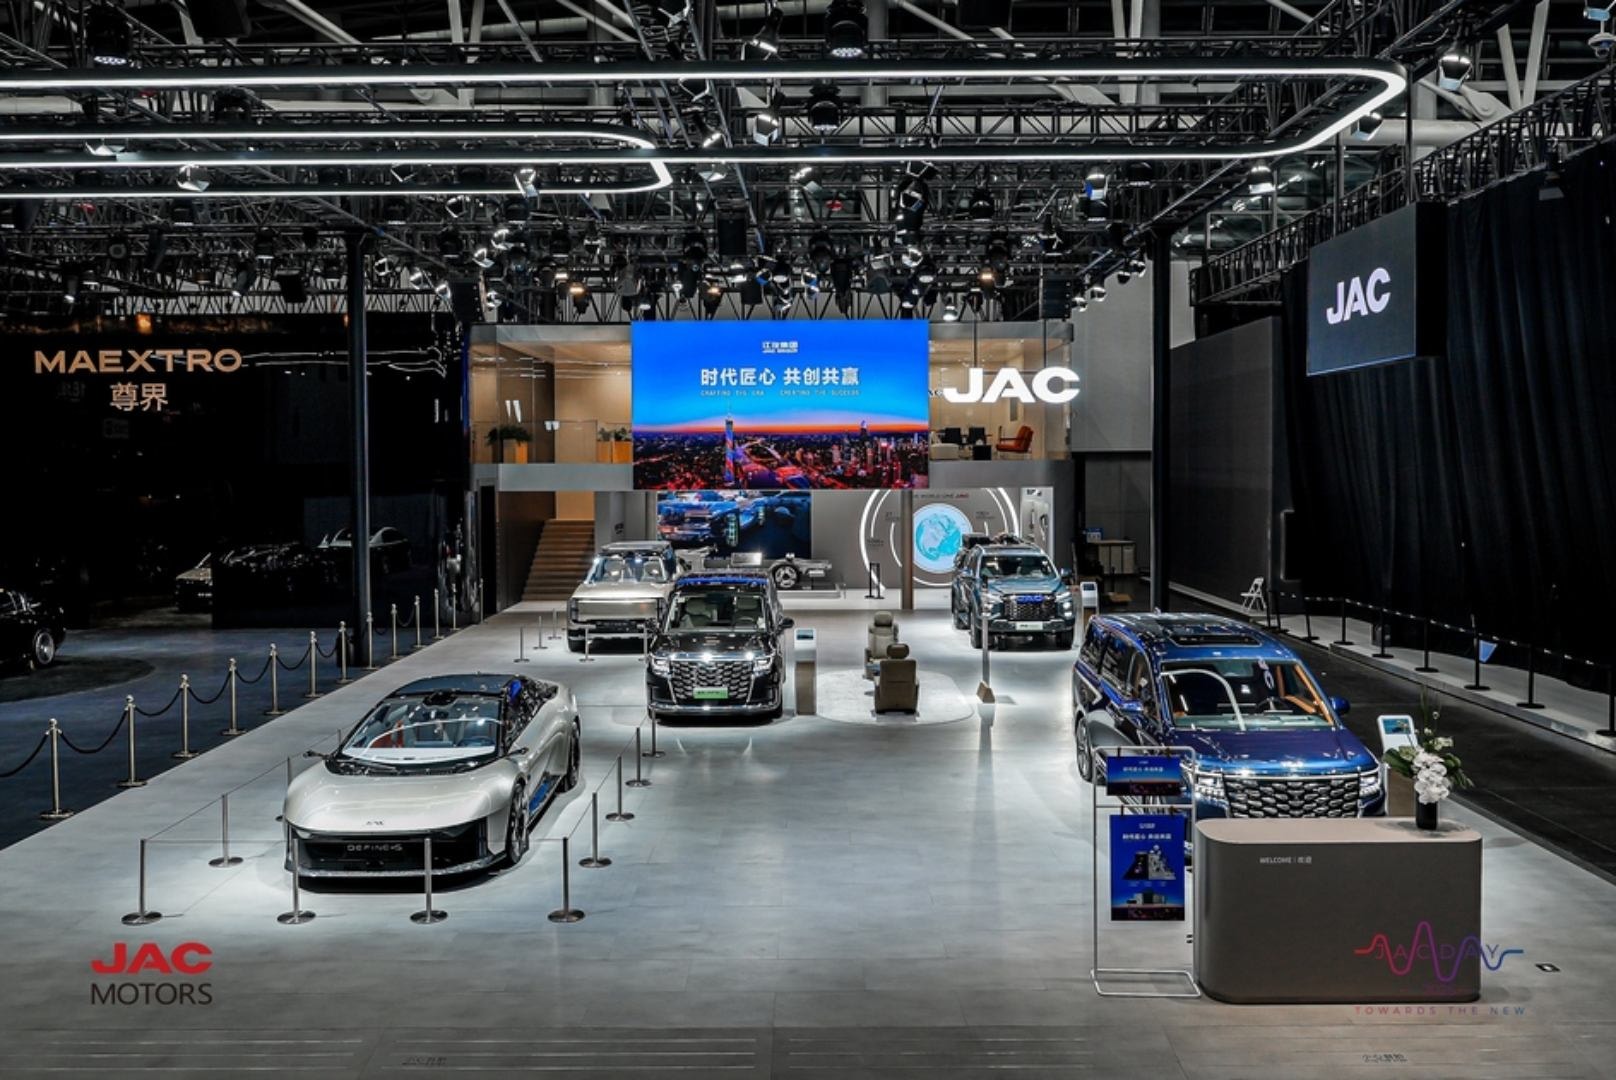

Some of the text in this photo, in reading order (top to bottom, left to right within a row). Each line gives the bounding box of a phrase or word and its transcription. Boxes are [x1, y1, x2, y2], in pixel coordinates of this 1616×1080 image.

[1326, 267, 1391, 325] JAC
[34, 349, 243, 374] MAEXTRO
[701, 367, 859, 386] 时代匠心 共创共赢
[942, 366, 1081, 403] JAC
[109, 382, 169, 412] 尊界
[1259, 856, 1291, 864] WELCOME
